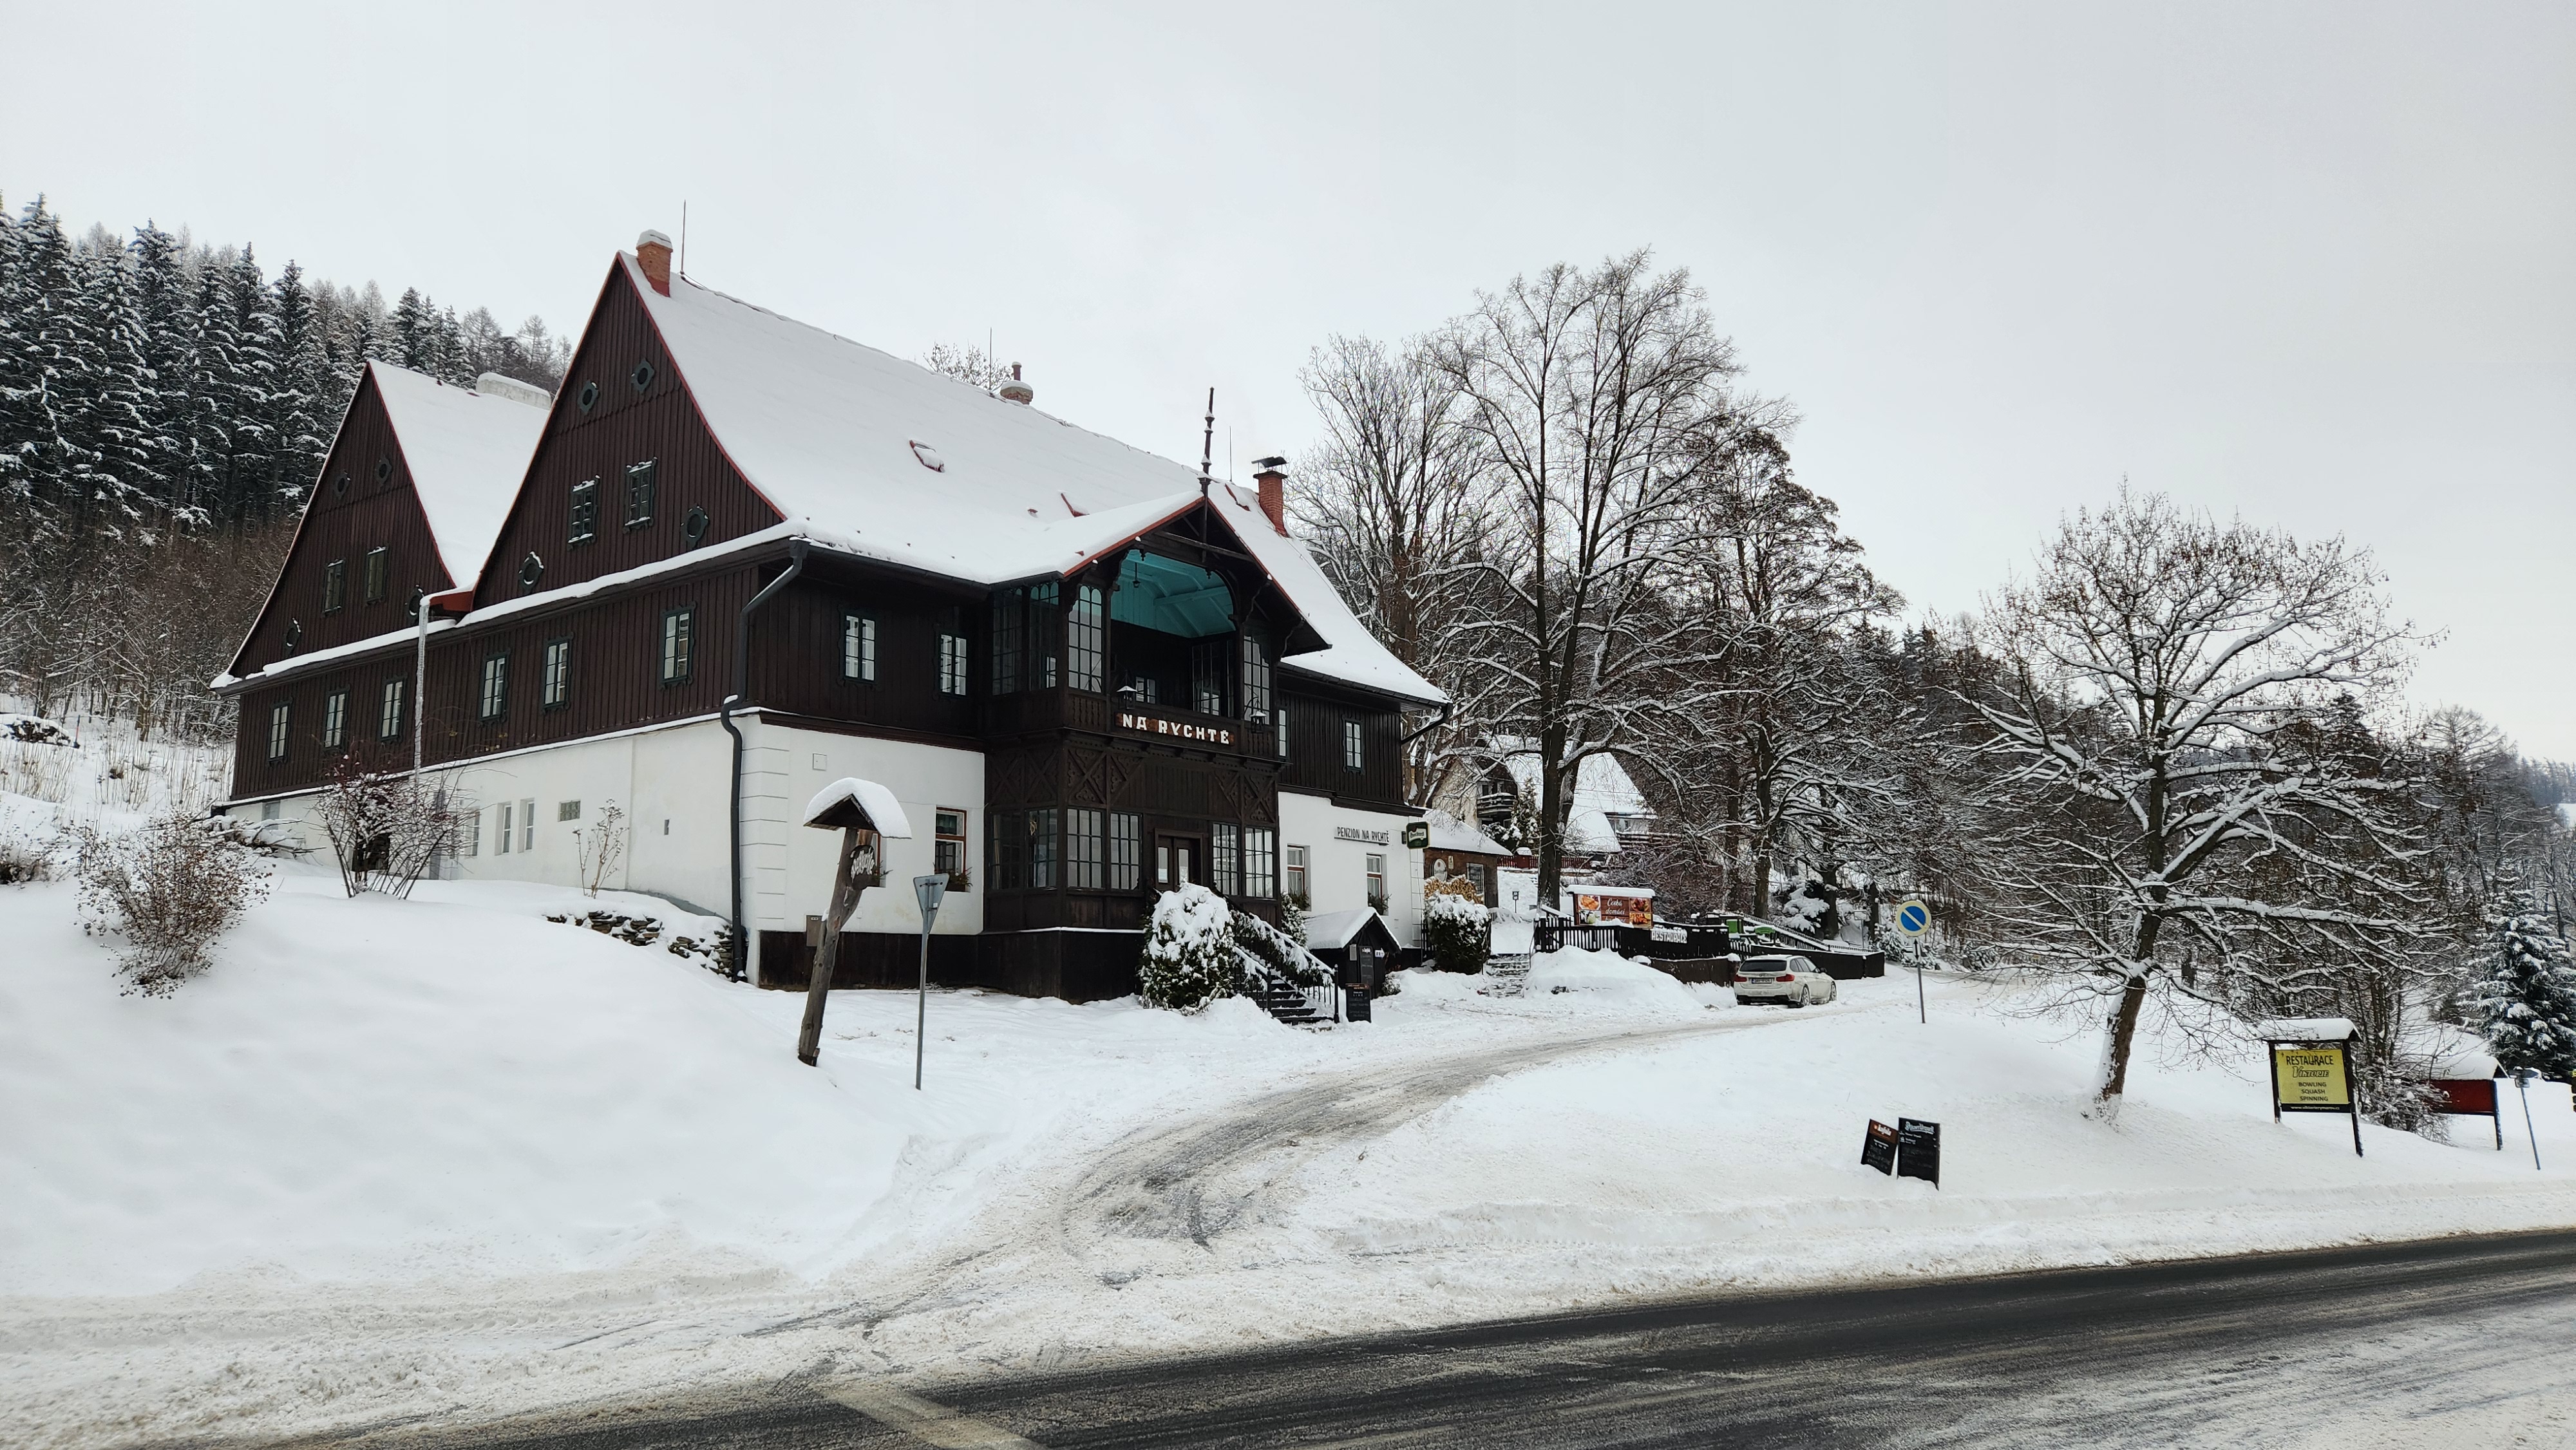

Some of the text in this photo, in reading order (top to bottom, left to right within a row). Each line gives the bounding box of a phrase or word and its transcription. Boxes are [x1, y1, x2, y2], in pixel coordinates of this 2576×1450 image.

[1122, 713, 1229, 744] NA RYCHTĚ
[1337, 827, 1389, 843] PENZION NA RYCHTĚ
[1651, 931, 1687, 944] RESTAURACE
[2286, 1055, 2334, 1066] RESTAURACE
